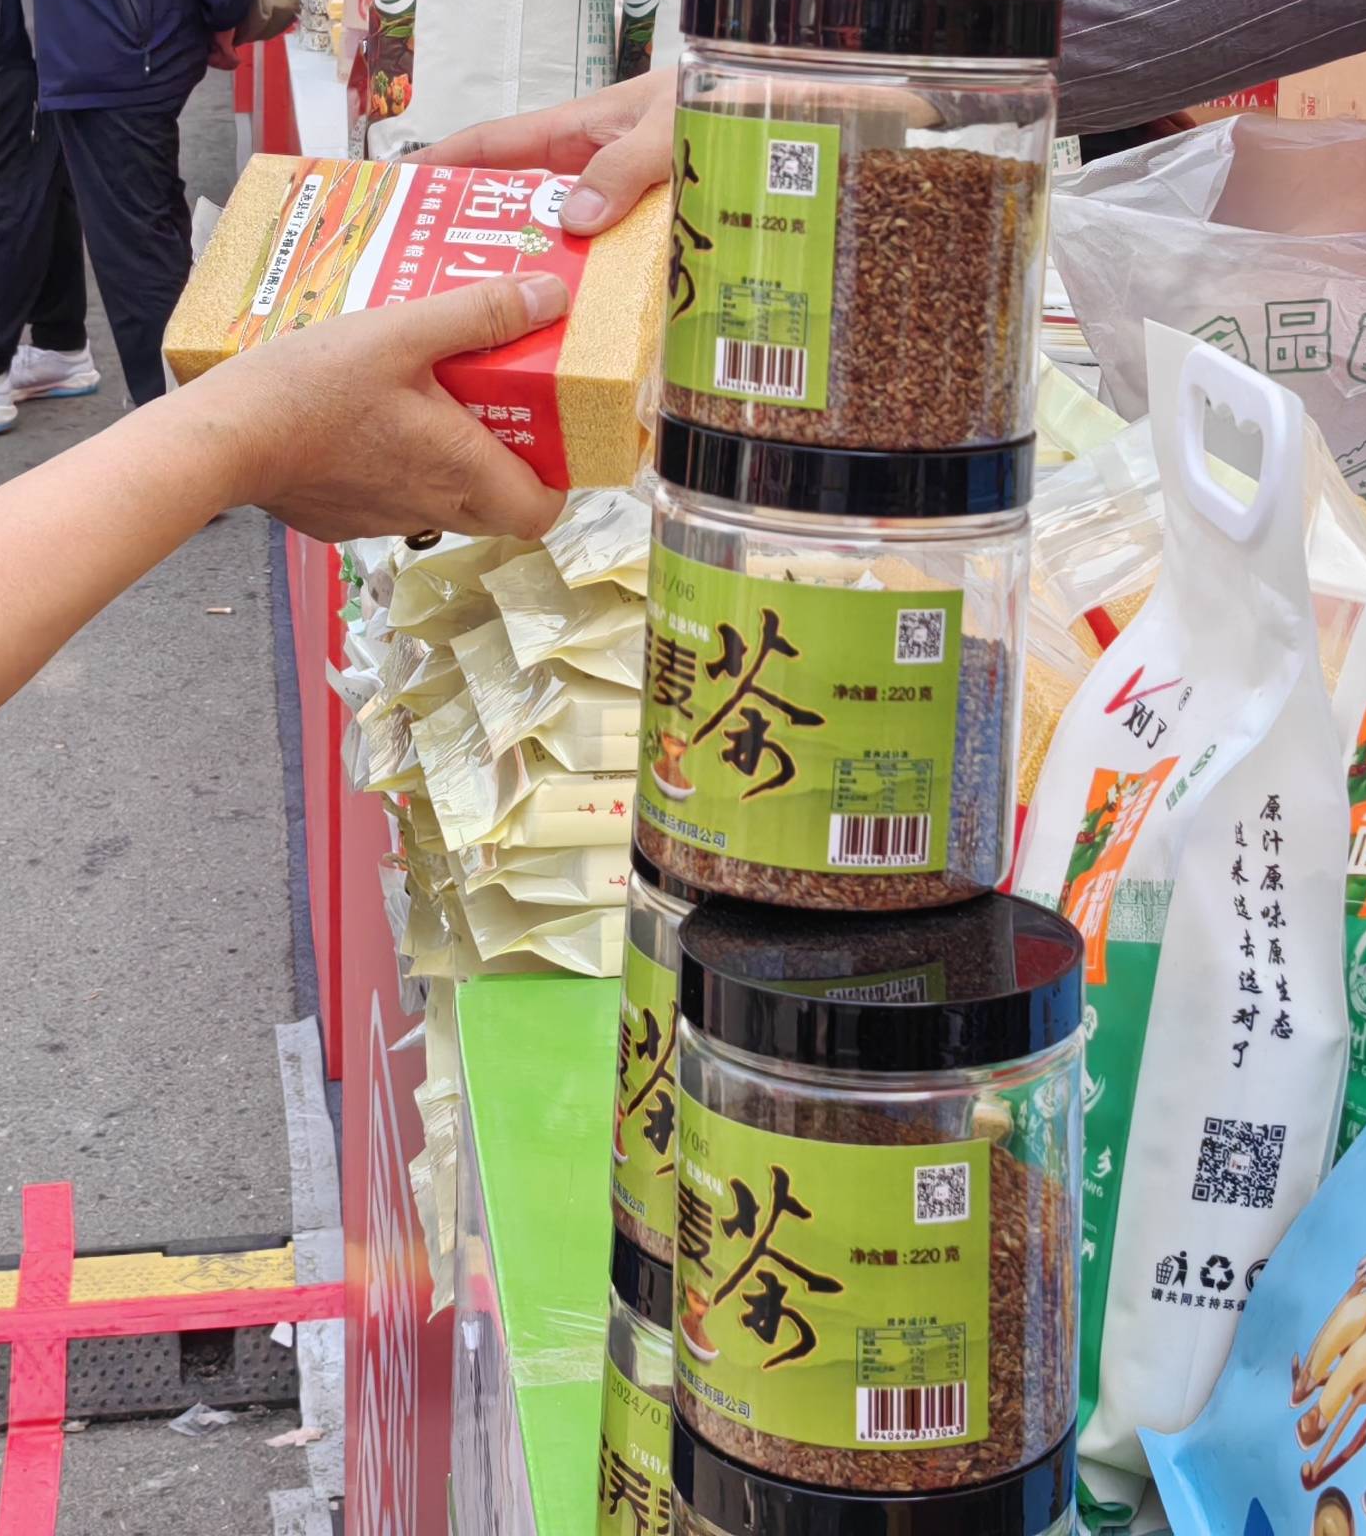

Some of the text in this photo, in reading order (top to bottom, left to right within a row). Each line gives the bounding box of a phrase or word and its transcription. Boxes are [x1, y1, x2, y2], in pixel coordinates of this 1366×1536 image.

[1230, 820, 1264, 1069] 选来选去选对了
[1259, 794, 1294, 1041] 原汁原味原生态
